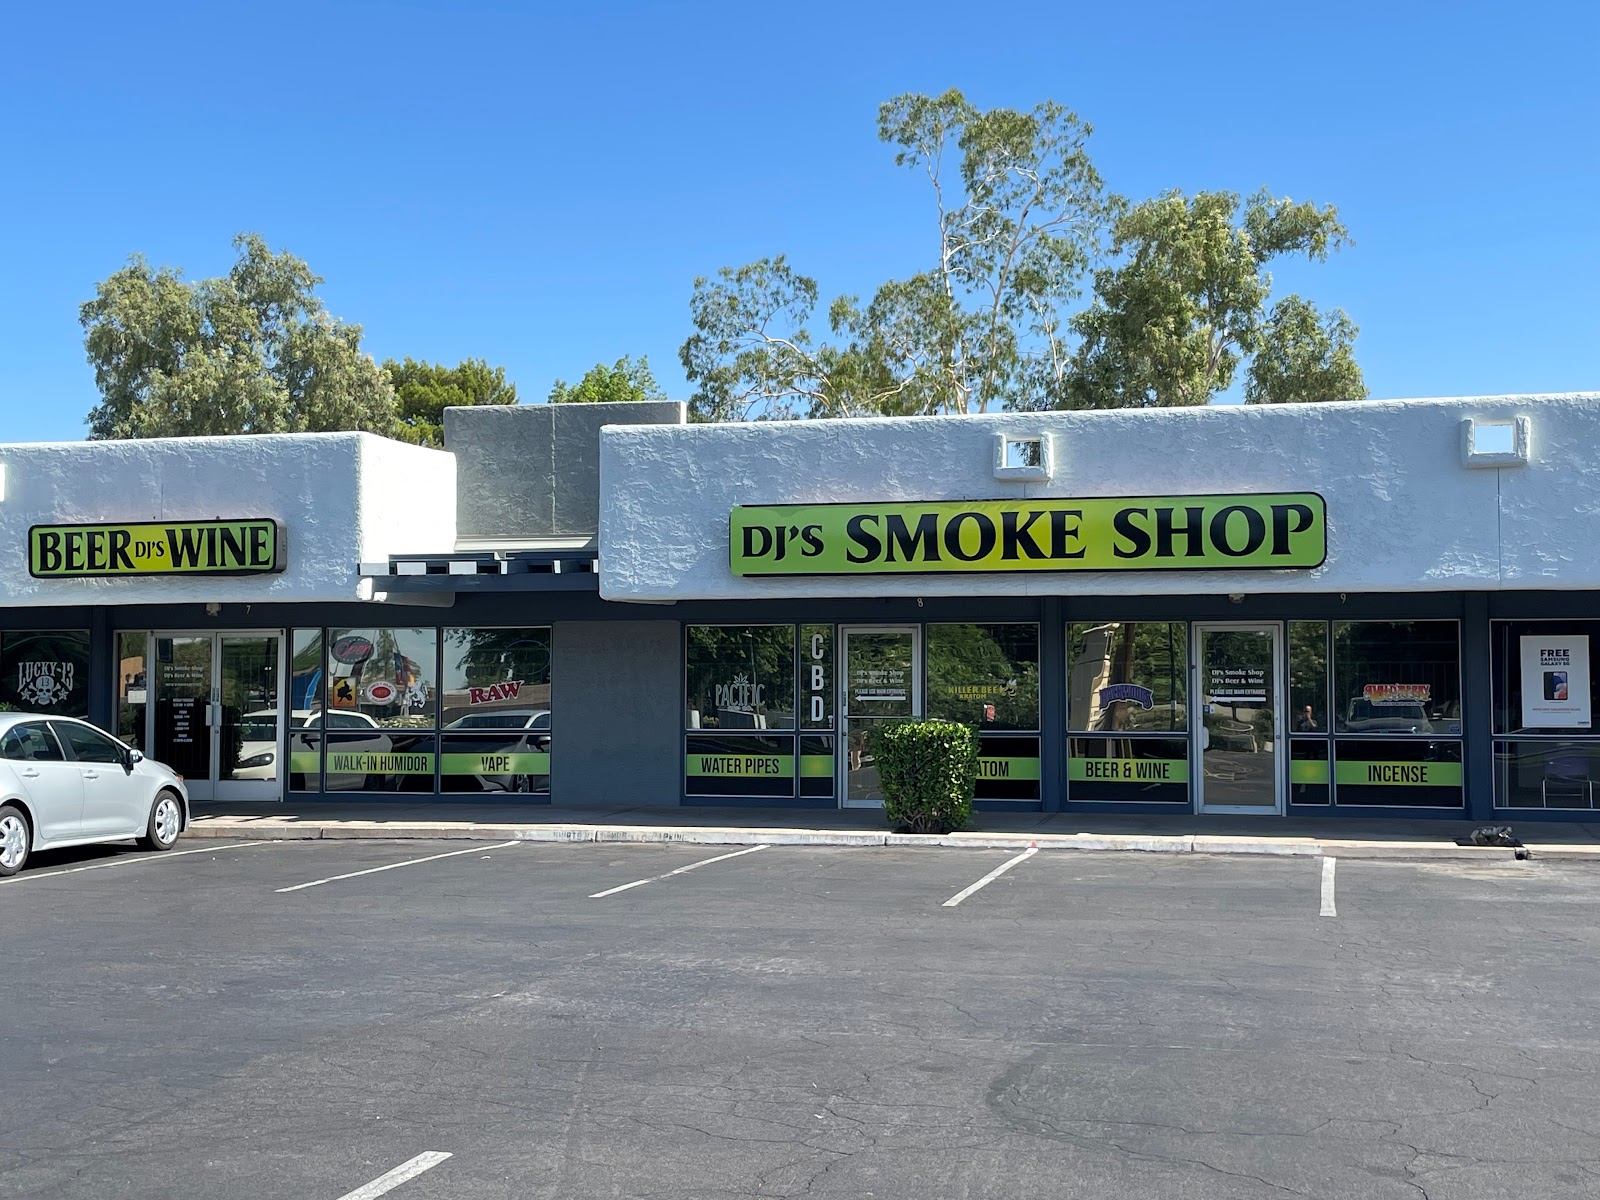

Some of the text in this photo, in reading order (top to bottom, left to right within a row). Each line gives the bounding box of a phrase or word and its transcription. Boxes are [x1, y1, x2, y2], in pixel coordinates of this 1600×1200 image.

[742, 503, 1314, 563] DJ'S SMOKE SHOP
[38, 526, 272, 572] BEER DJ'S WINE
[916, 598, 924, 608] 8
[1340, 593, 1347, 604] 9
[246, 605, 251, 615] 7
[1540, 649, 1570, 657] FREE
[811, 633, 824, 722] CBD
[1247, 669, 1264, 677] Shop
[41, 677, 50, 687] 13
[948, 686, 998, 694] KILLER BEE
[469, 680, 524, 704] RAW
[715, 683, 766, 707] PACIFIC
[333, 756, 428, 772] WALK-IN HUMIDOR
[481, 756, 510, 772] VAPE
[701, 757, 779, 774] WATER PIPES
[1085, 761, 1170, 779] BEER & WINE
[1368, 765, 1428, 783] INCENSE
